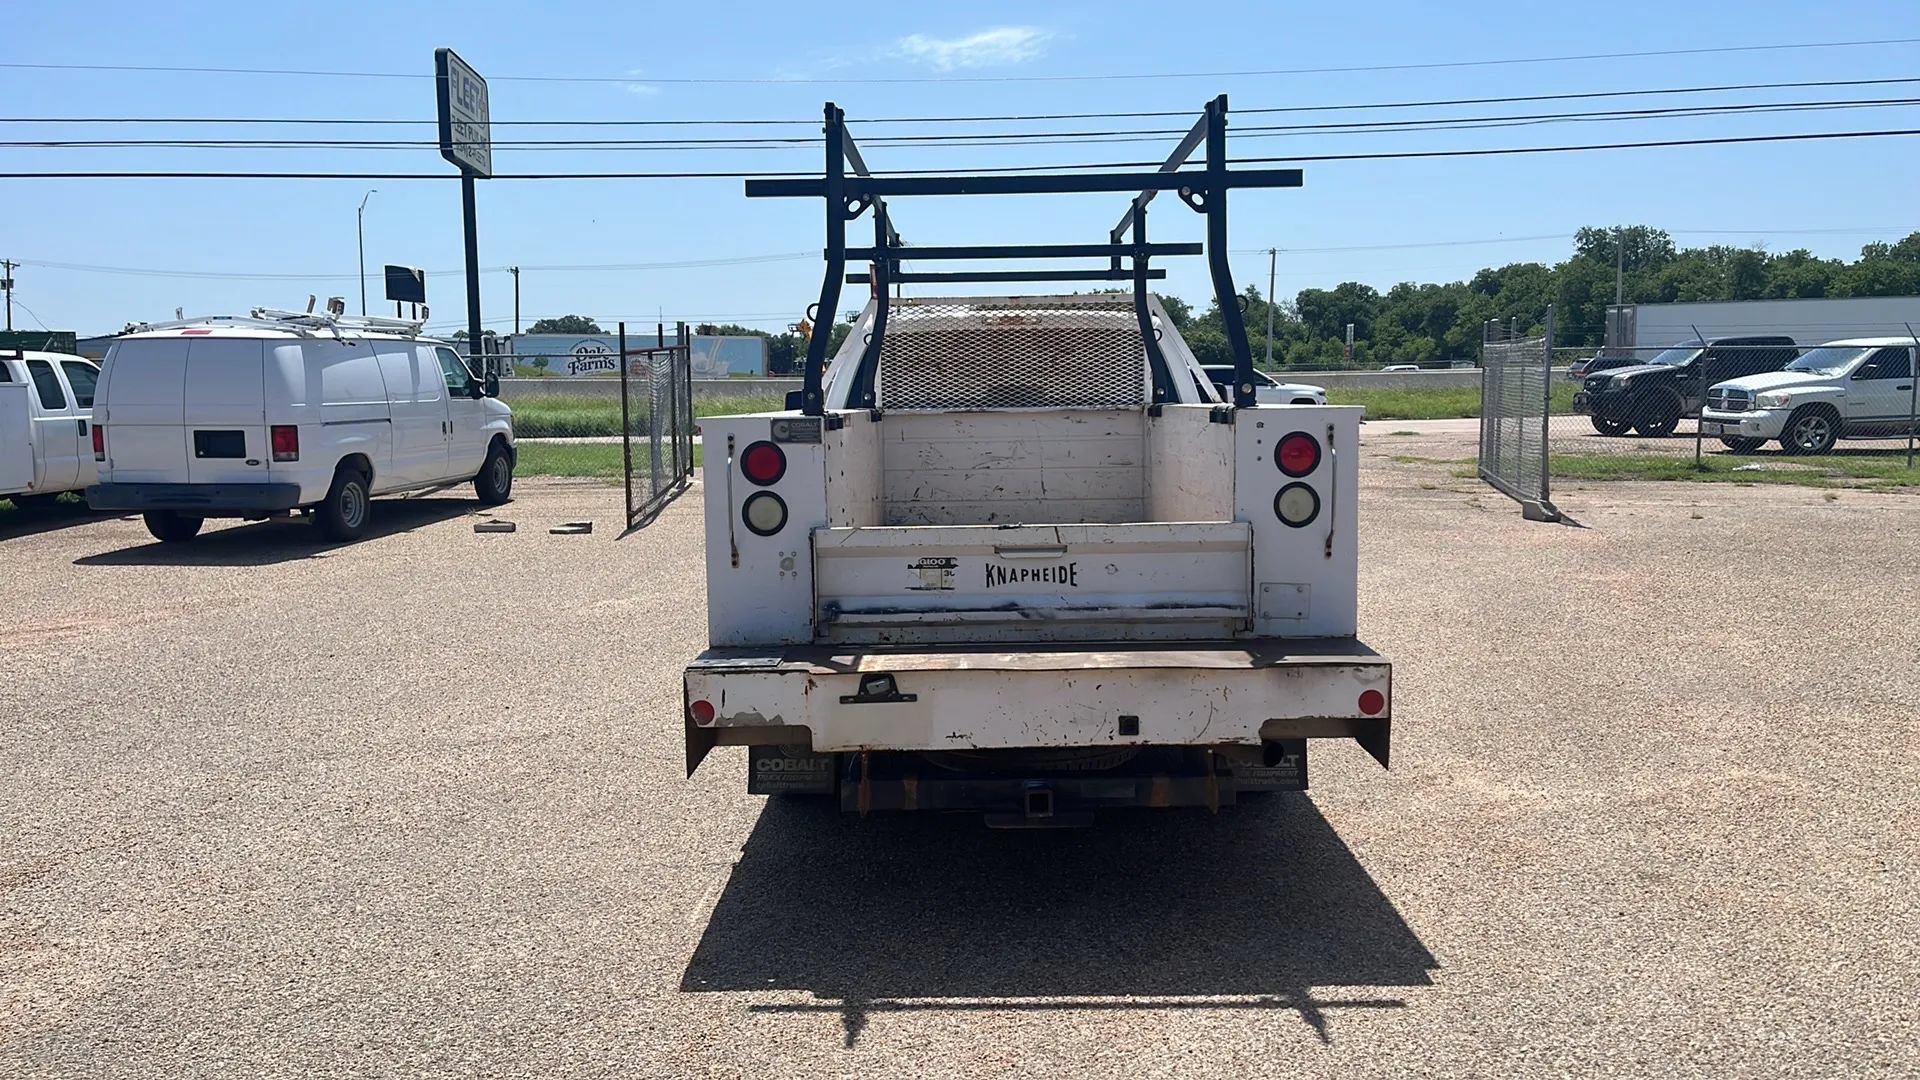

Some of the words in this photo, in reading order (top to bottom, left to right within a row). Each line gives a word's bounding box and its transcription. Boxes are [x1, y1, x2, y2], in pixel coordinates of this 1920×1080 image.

[450, 66, 480, 118] FLEET
[575, 345, 610, 362] Oak
[567, 359, 616, 376] Farms
[985, 561, 1079, 589] KNAPHEIDE
[756, 757, 830, 772] COBALT
